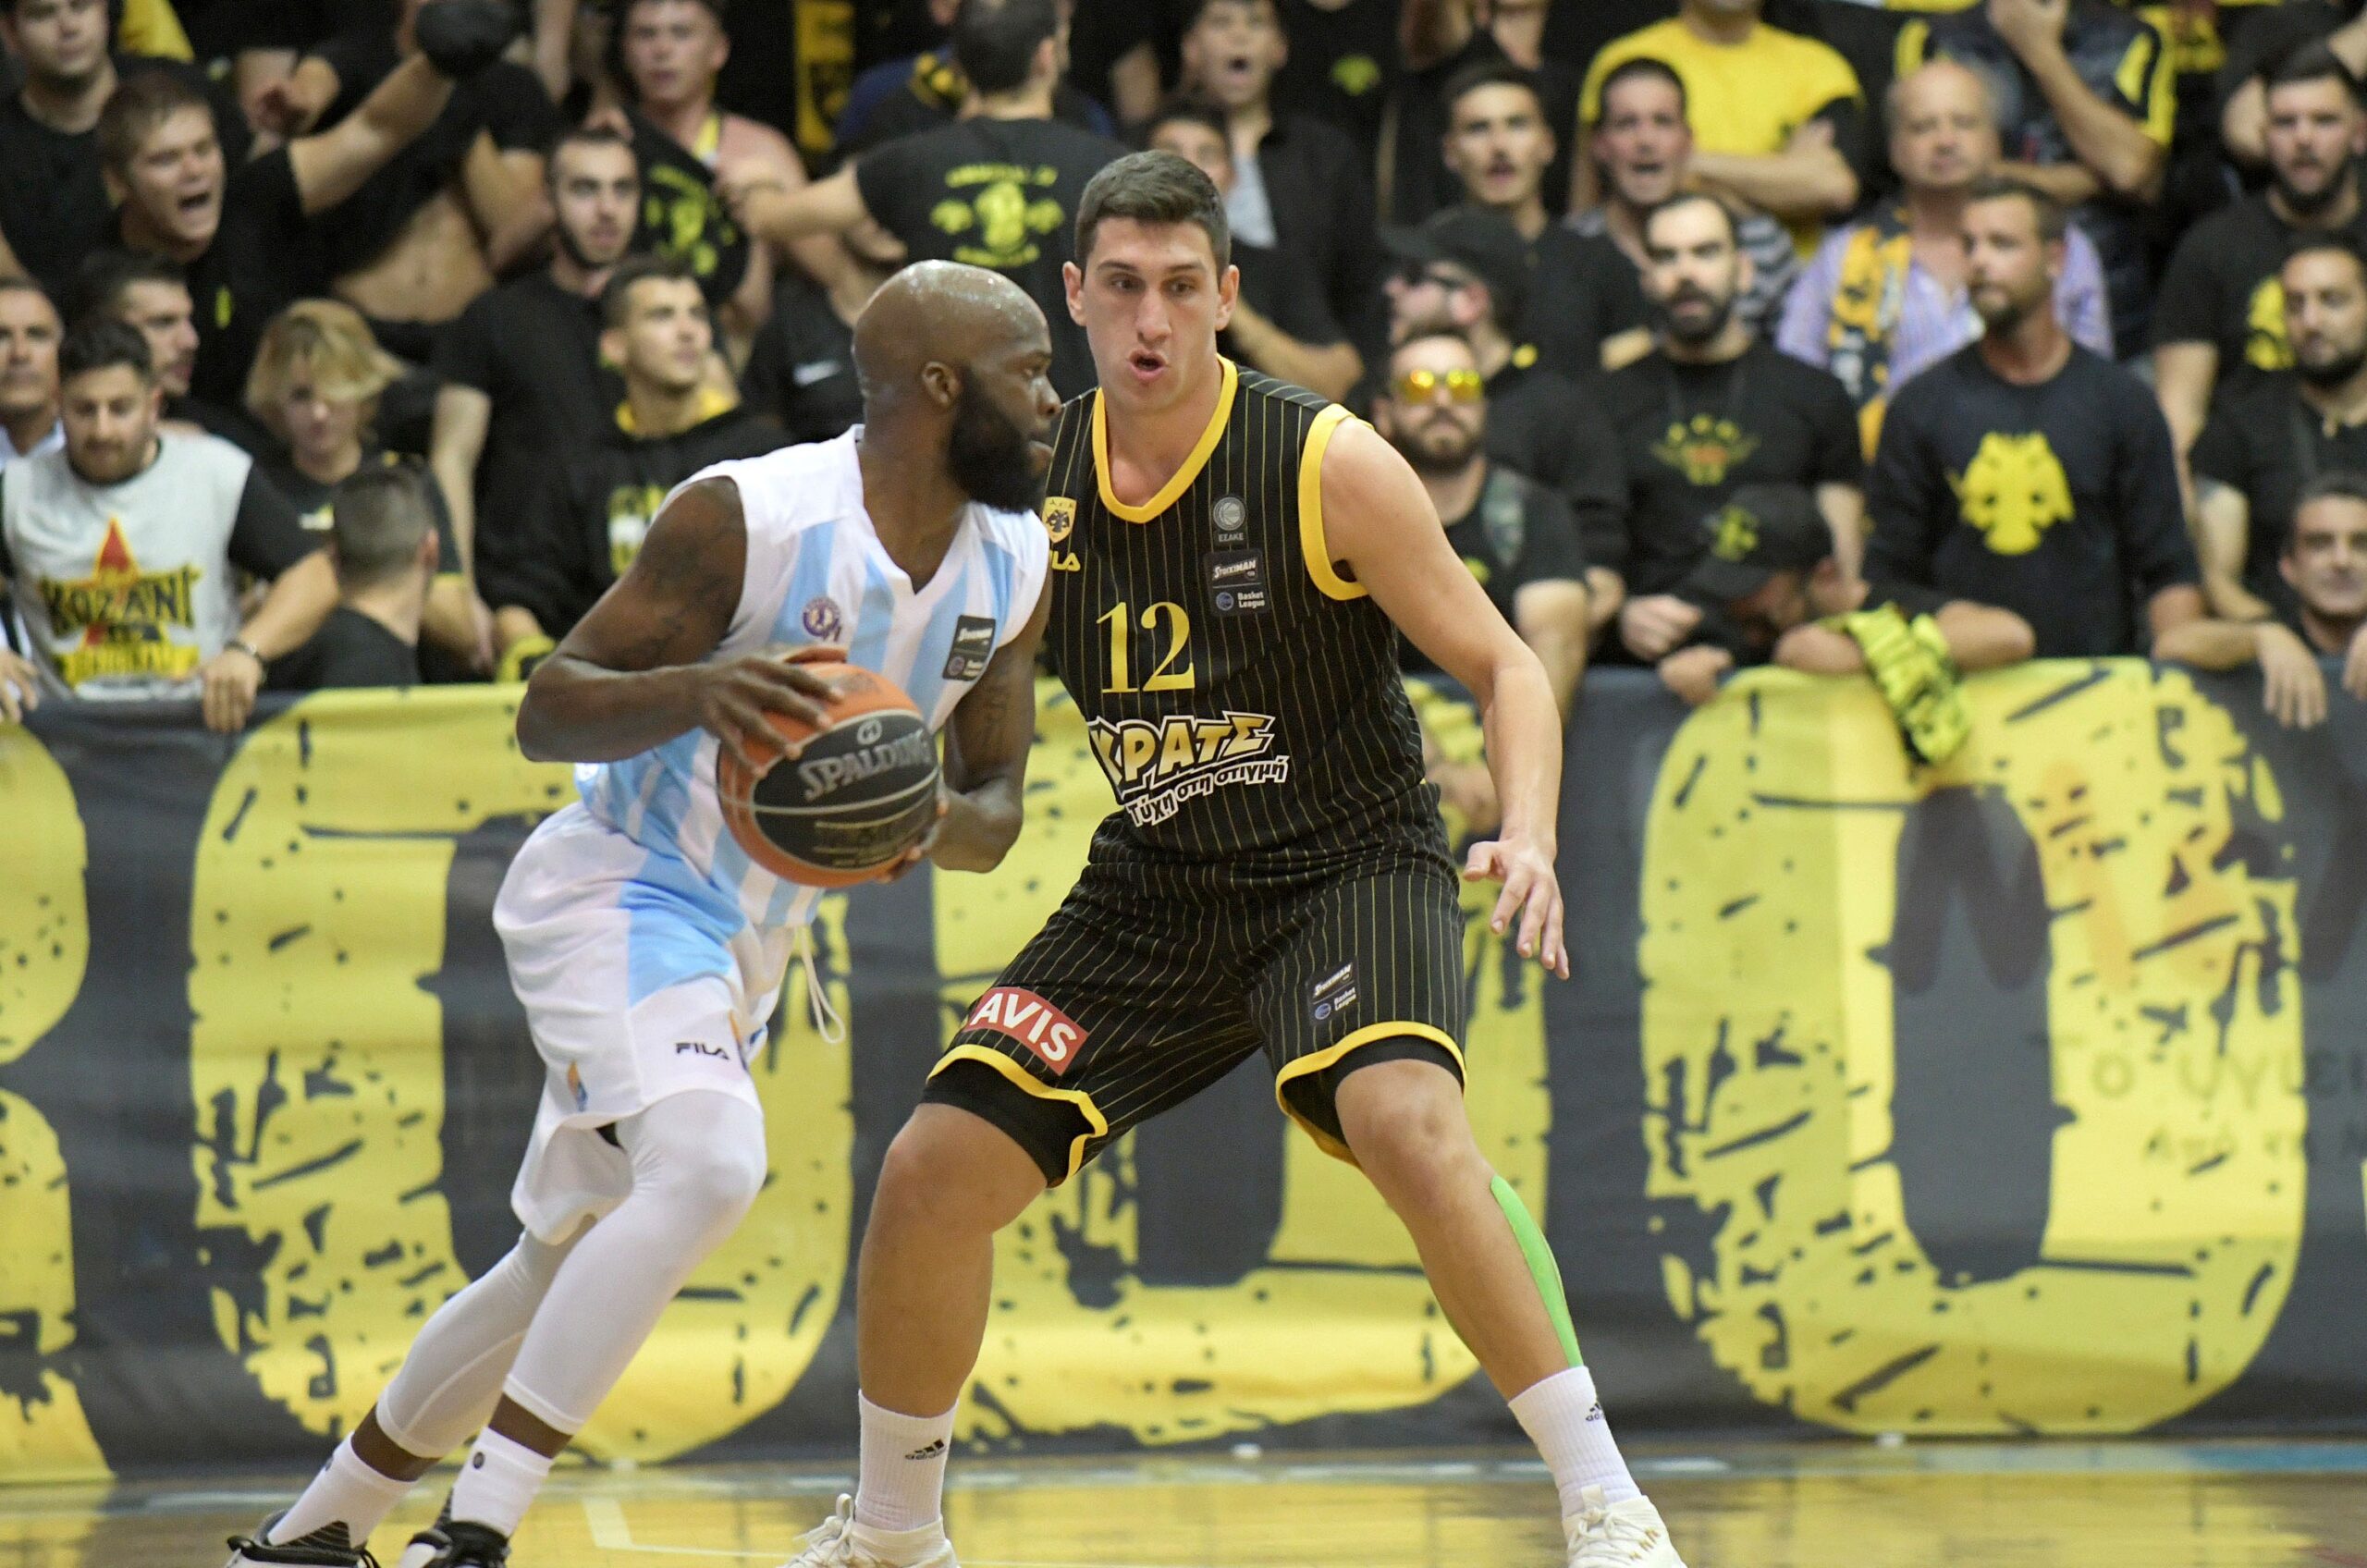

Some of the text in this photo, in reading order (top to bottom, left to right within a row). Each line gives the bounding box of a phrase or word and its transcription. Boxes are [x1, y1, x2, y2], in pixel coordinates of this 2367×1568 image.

[1049, 549, 1081, 572] LA
[1237, 591, 1264, 601] Basket
[1239, 600, 1266, 609] League
[1096, 601, 1196, 694] 12
[1125, 754, 1291, 828] Τύχη στη στιγμή
[968, 991, 1078, 1062] AVIS
[675, 1041, 730, 1060] FILA
